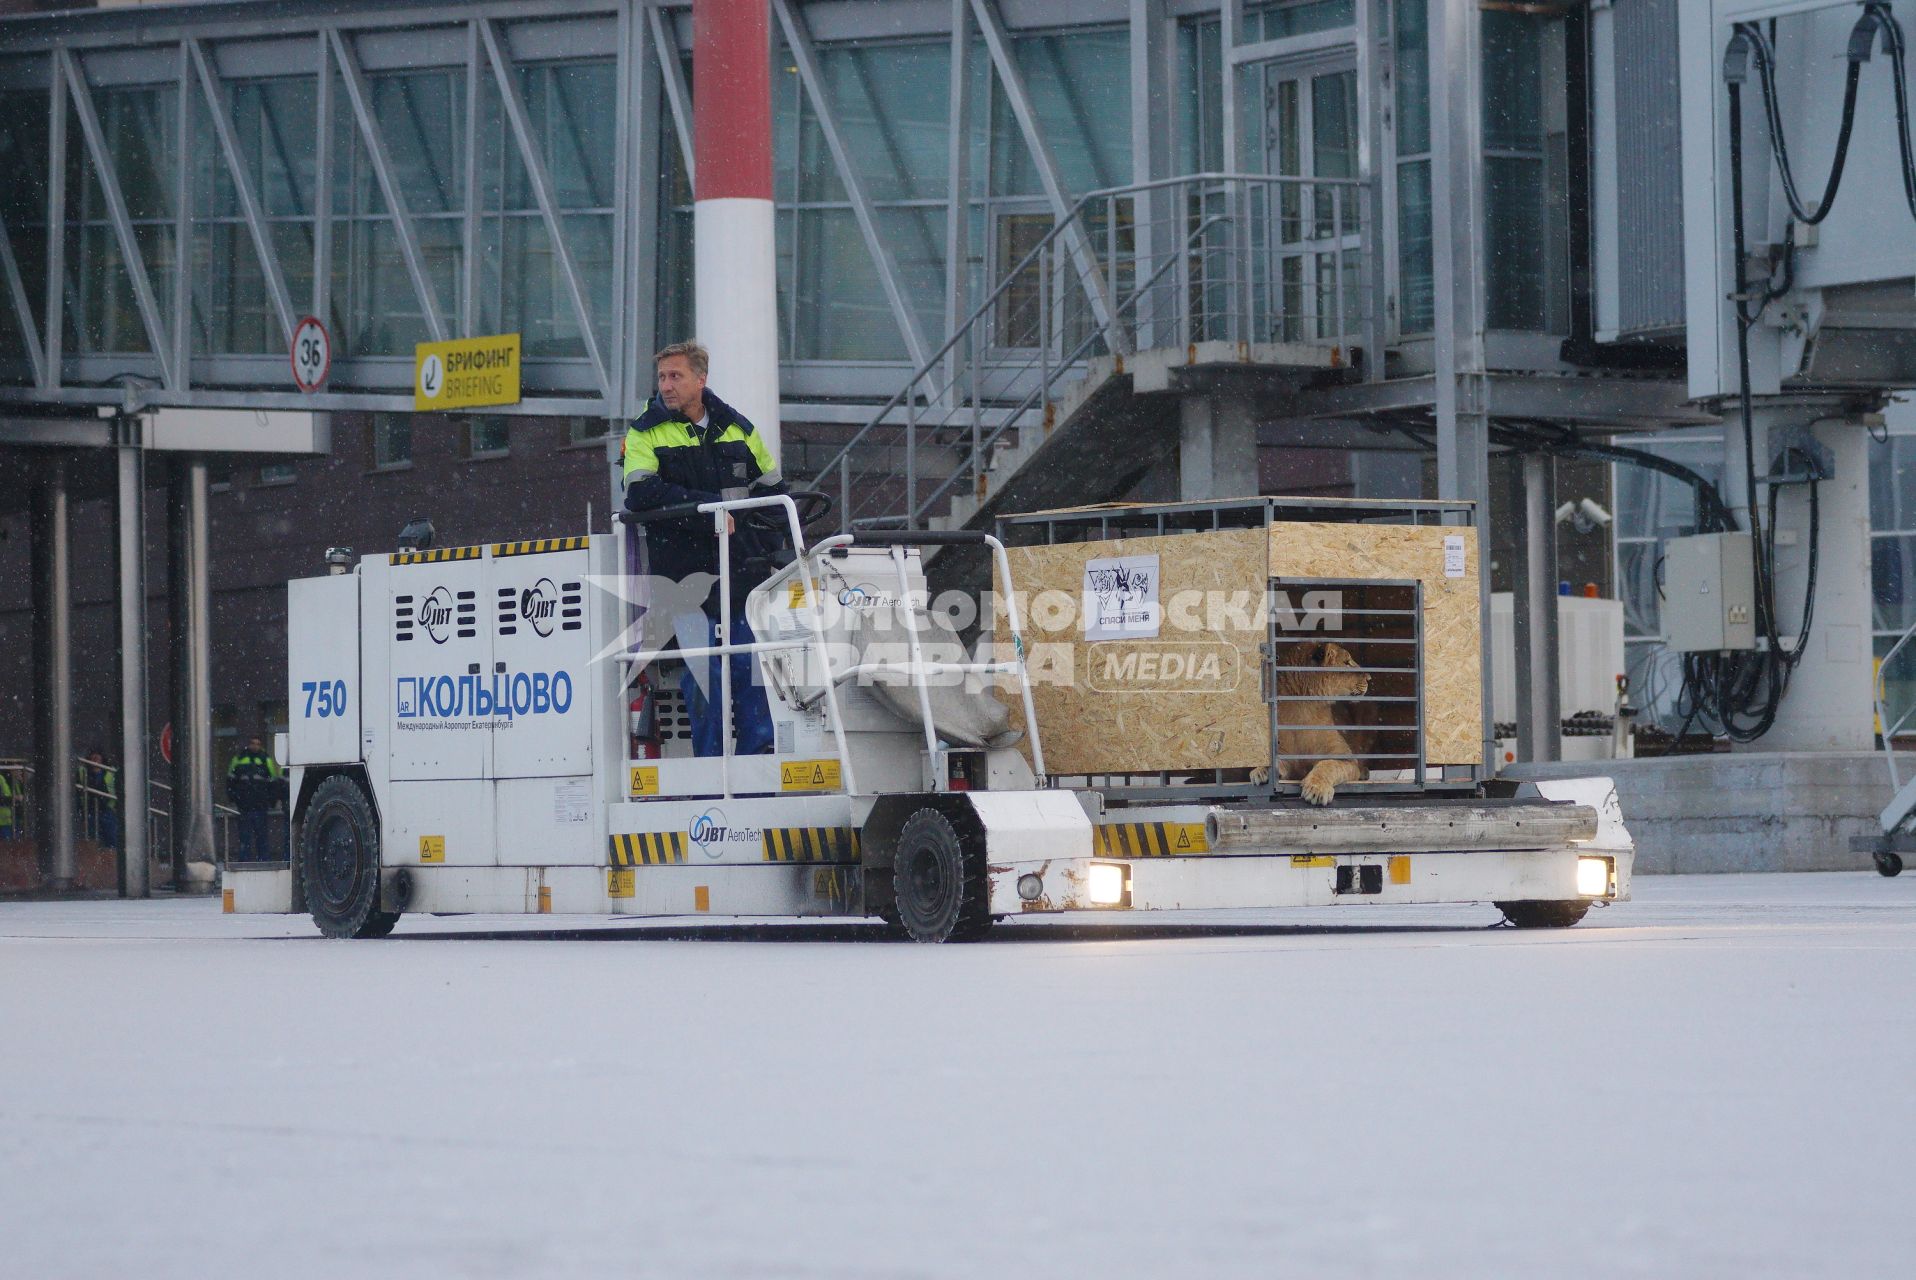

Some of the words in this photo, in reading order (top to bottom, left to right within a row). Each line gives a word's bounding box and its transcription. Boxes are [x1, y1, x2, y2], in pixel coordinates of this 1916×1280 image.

[447, 347, 513, 373] БРИФИНГ
[446, 374, 502, 399] BRIEFING
[431, 607, 453, 625] JBT
[534, 600, 557, 618] JBT
[1099, 615, 1126, 625] СПАСИ
[1128, 614, 1150, 623] МЕНЯ
[302, 679, 347, 718] 750
[419, 670, 573, 720] КОЛЬЦОВО
[397, 721, 444, 732] Международный
[444, 721, 471, 732] Аэропорт
[702, 826, 727, 842] JBT
[727, 827, 762, 842] AeroTech
